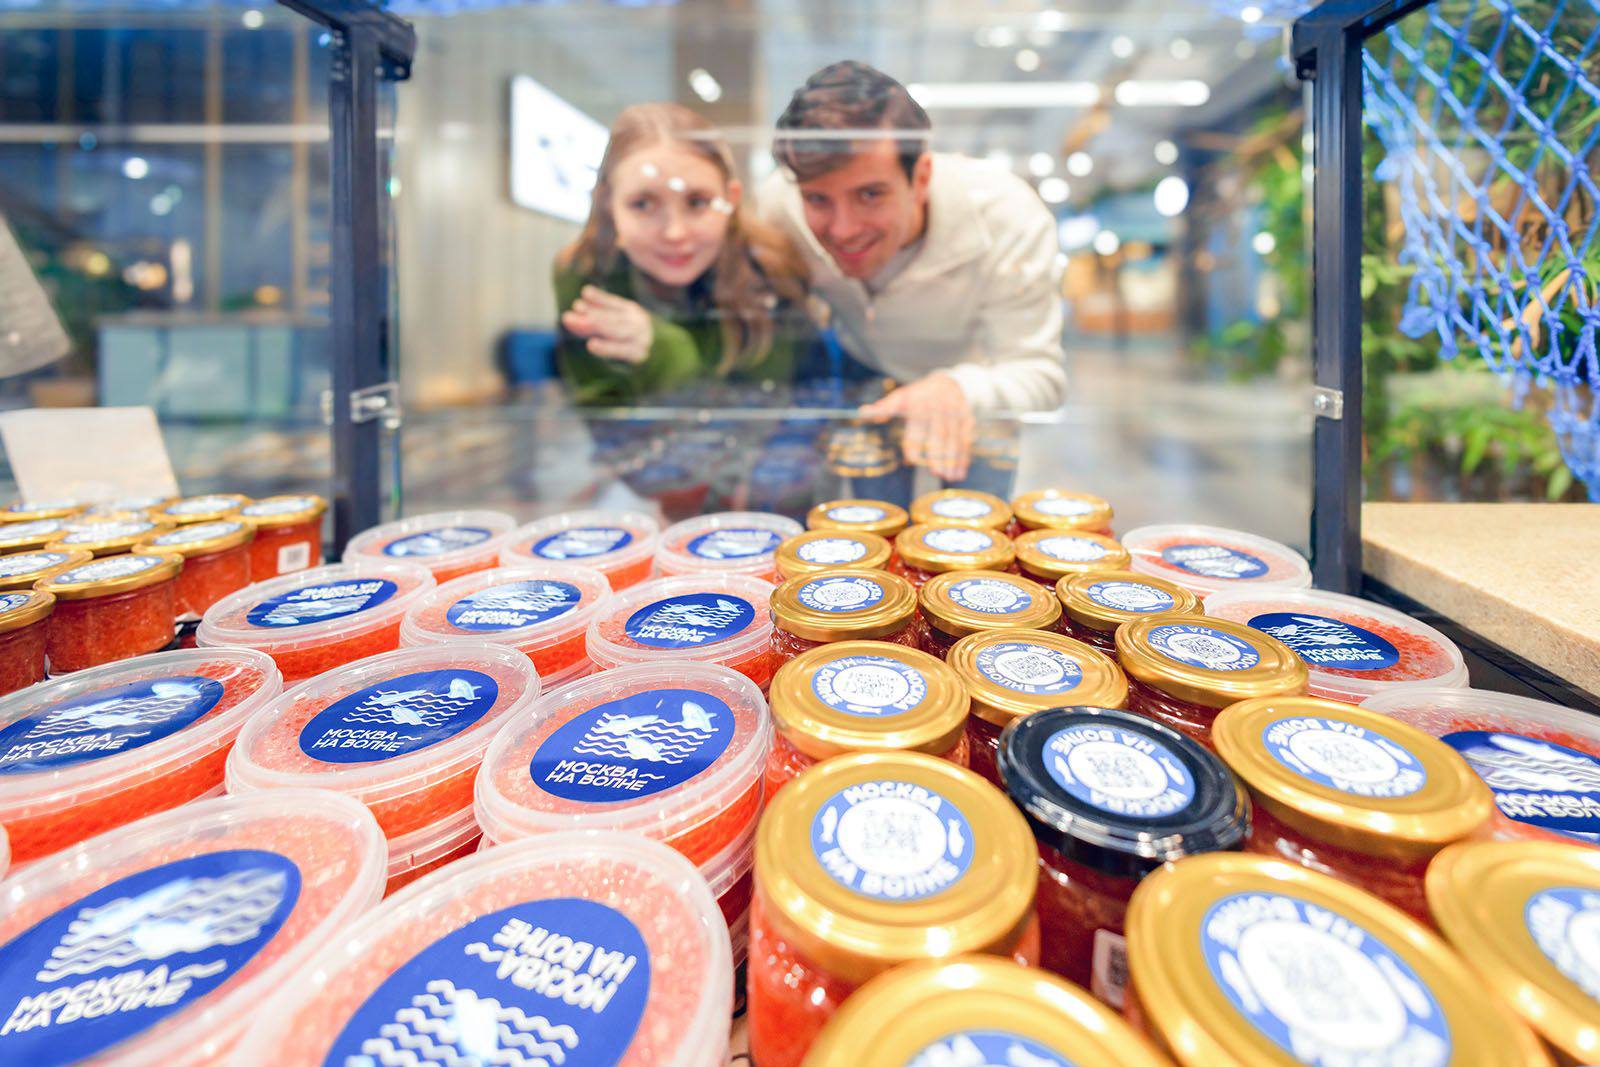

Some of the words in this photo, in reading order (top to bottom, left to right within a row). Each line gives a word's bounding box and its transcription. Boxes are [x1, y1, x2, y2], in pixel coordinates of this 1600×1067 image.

[640, 625, 698, 635] МОСКВА
[1151, 626, 1185, 646] ВОЛНЕ
[1187, 626, 1212, 636] НА
[981, 663, 1036, 692] ВОЛНЕ
[7, 733, 112, 754] МОСКВА
[311, 739, 340, 749] НА
[340, 739, 404, 752] ВОЛНЕ
[322, 728, 398, 741] МОСКВА
[1051, 729, 1115, 755] ВОЛНЕ
[1121, 733, 1155, 755] НА
[0, 750, 32, 762] НА
[39, 738, 129, 757] ВОЛНЕ
[544, 771, 576, 784] НА
[578, 774, 648, 791] ВОЛНЕ
[554, 760, 639, 779] МОСКВА
[843, 781, 942, 813] МОСКВА
[1501, 804, 1547, 817] НА
[821, 847, 858, 886] НА
[860, 857, 961, 898] ВОЛНЕ
[492, 917, 595, 972] ВОЛНЕ
[588, 946, 637, 985] НА
[12, 964, 169, 1018] МОСКВА
[496, 948, 619, 1014] МОСКВА
[0, 1010, 52, 1036] НА
